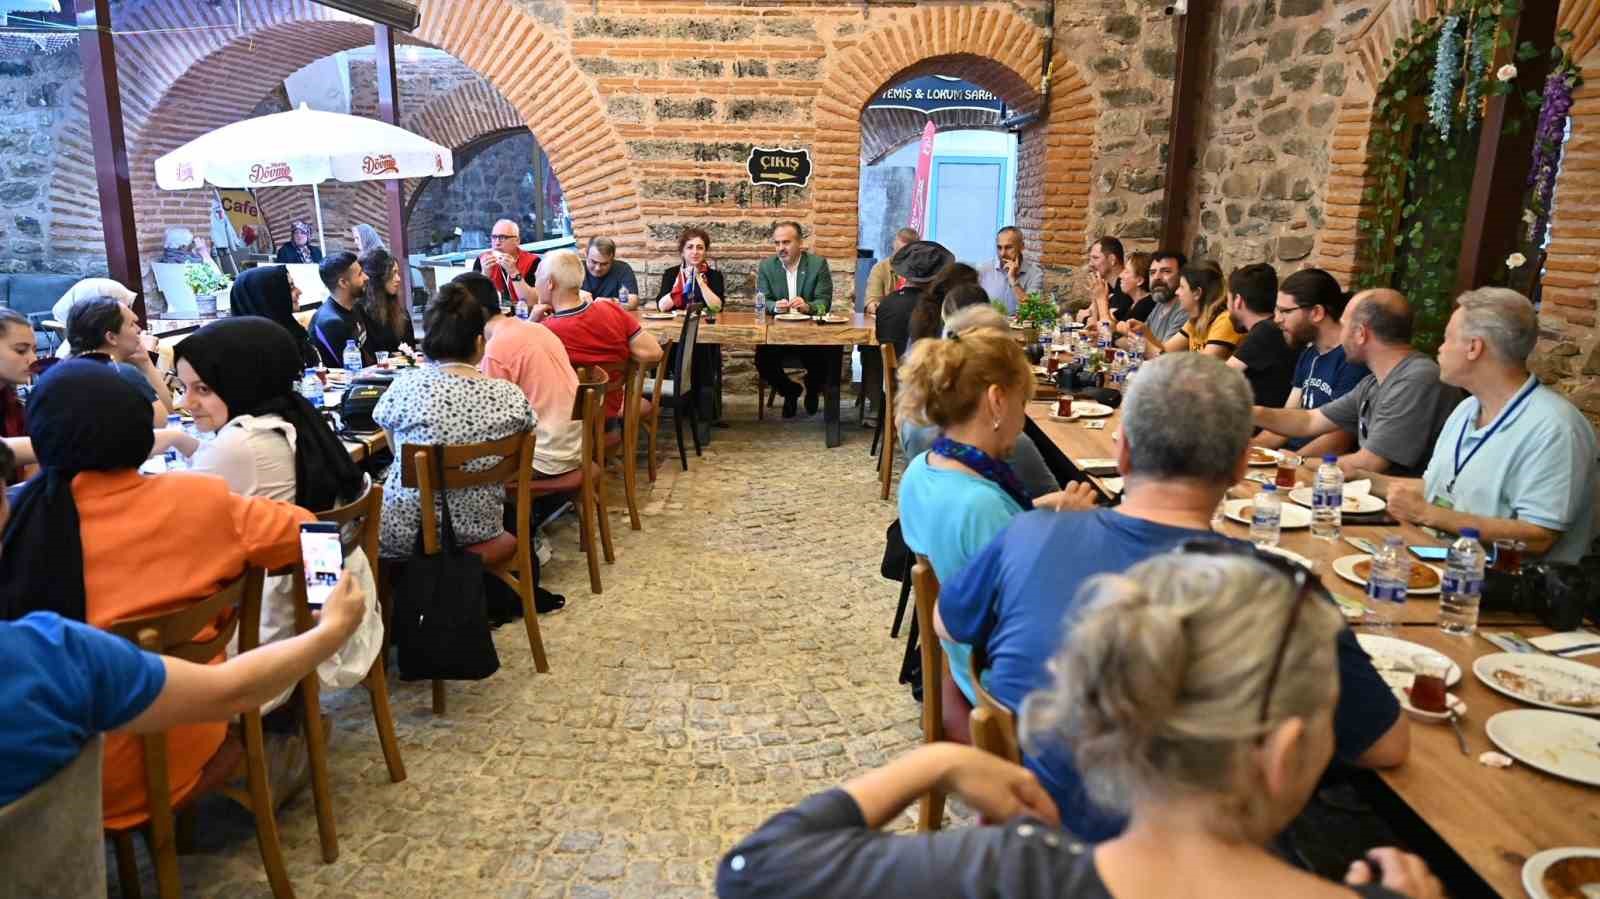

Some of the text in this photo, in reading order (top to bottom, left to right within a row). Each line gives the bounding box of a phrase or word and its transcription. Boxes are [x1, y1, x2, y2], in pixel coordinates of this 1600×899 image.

[914, 89, 924, 99] &
[927, 89, 962, 100] LOKUM
[964, 89, 997, 100] SARA
[760, 156, 800, 171] ÇIKIŞ
[221, 197, 258, 217] Cafe
